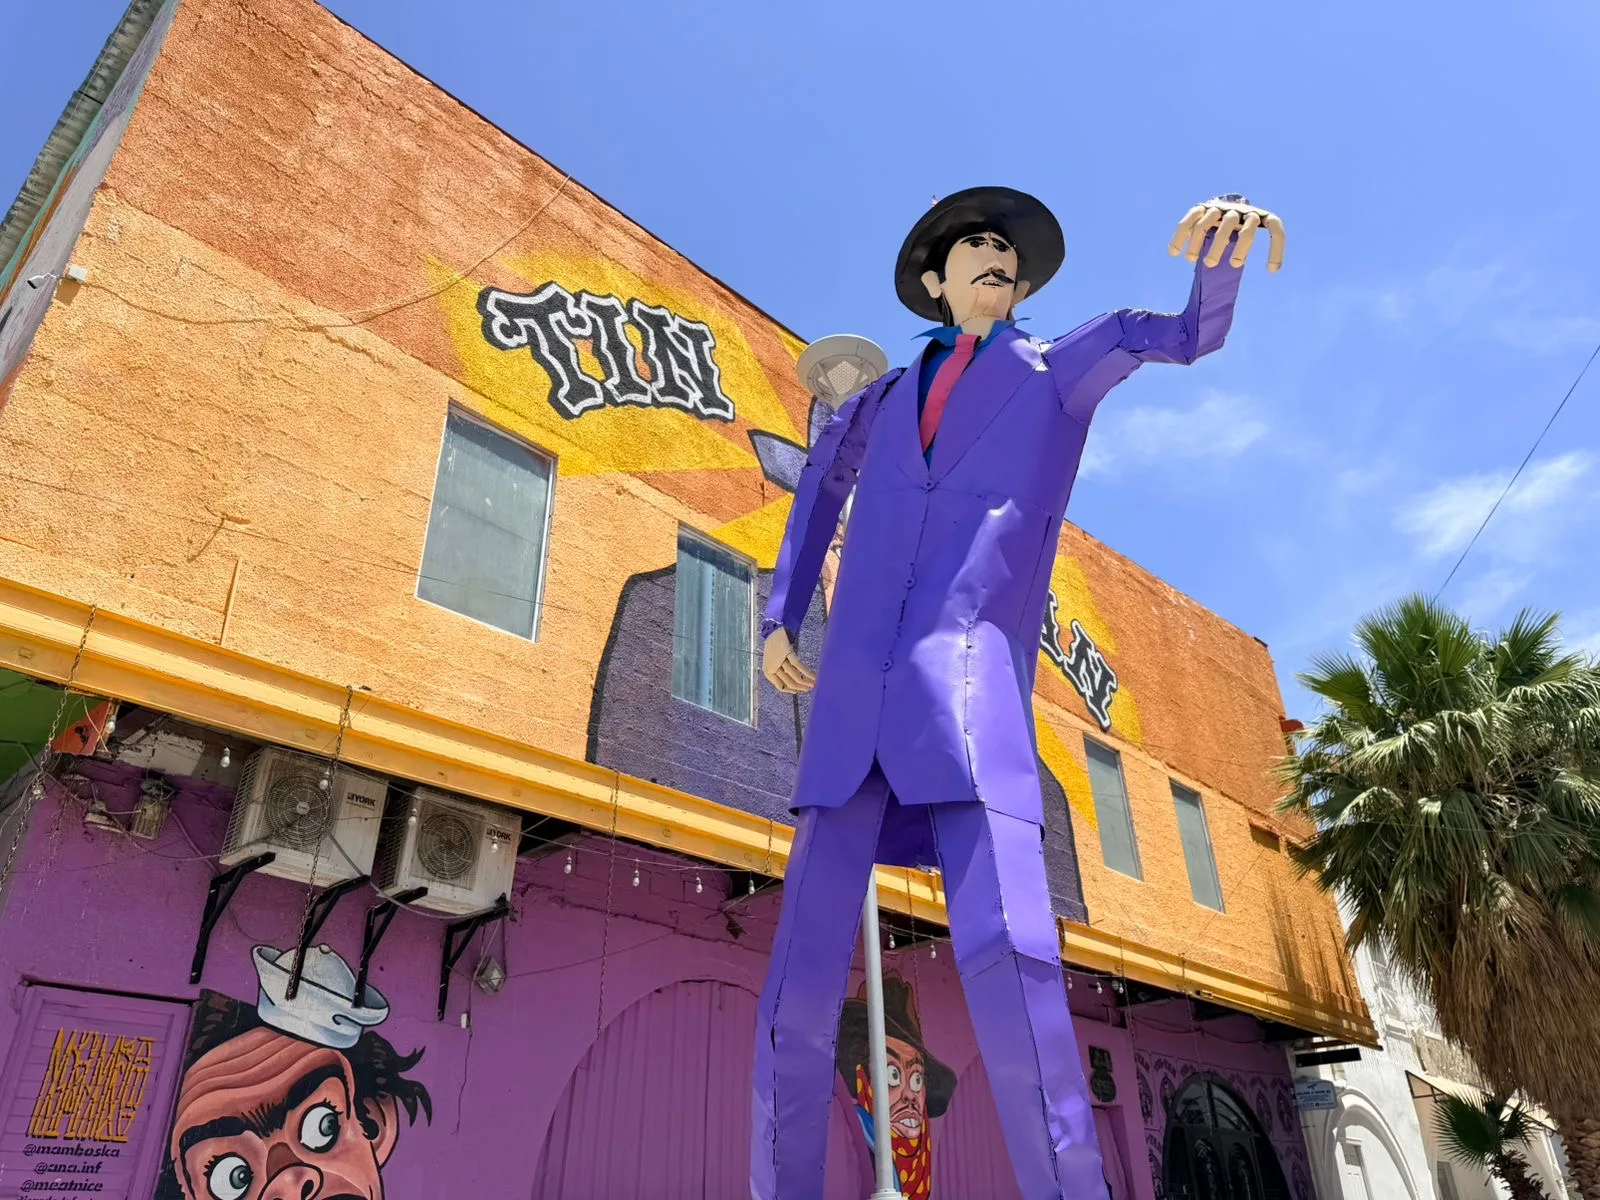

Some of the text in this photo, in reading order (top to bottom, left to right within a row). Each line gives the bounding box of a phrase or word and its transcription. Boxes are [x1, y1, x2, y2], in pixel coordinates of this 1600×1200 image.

[476, 281, 735, 420] TIN
[355, 794, 376, 807] YORK
[22, 1143, 120, 1158] @mamboska
